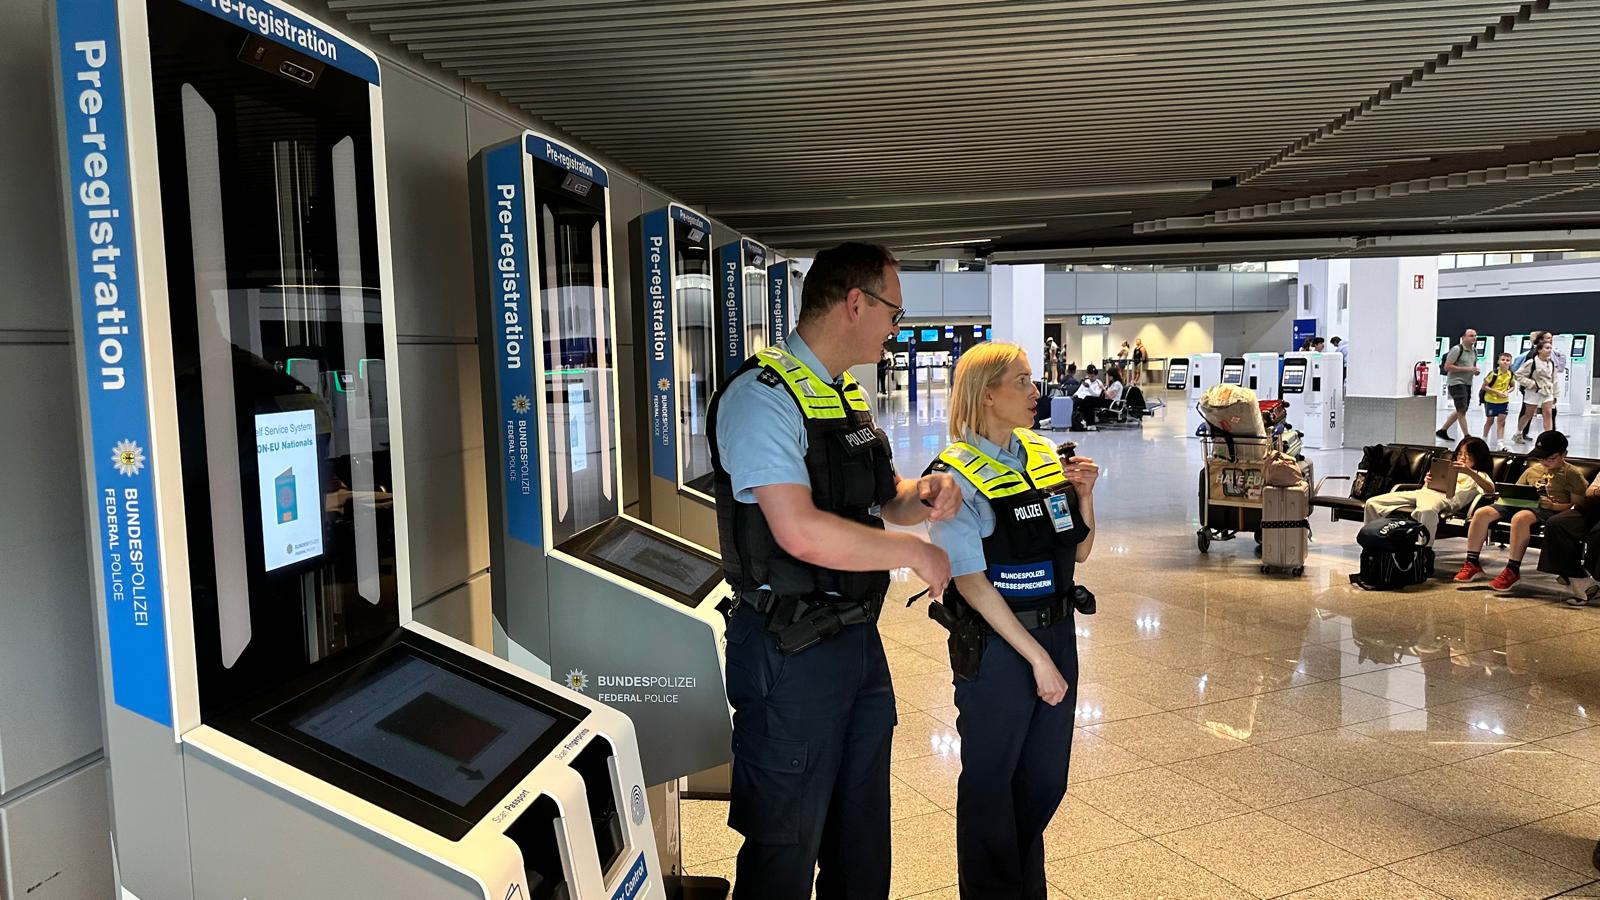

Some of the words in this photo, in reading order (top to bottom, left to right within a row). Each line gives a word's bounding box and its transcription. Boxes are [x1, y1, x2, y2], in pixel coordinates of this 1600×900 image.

[546, 143, 594, 178] Pre-registration
[75, 40, 129, 391] Pre-registration
[497, 184, 525, 369] Pre-registration
[650, 236, 665, 361] Pre-registration
[727, 261, 738, 357] Pre-registration
[774, 279, 784, 343] Pre-registrati
[264, 425, 289, 436] Service
[290, 423, 313, 434] System
[507, 420, 515, 455] FEDERAL
[661, 394, 669, 446] BUNDESPOLIZEI
[845, 427, 877, 448] POLIZEI
[257, 442, 280, 454] ON-EU
[282, 438, 313, 449] Nationals
[518, 420, 530, 495] BUNDESPOLIZEI
[105, 488, 119, 550] FEDERAL
[1014, 503, 1044, 521] POLIZEI
[110, 554, 124, 601] POLICE
[124, 488, 148, 626] BUNDESPOLIZEI
[1000, 569, 1045, 580] BUNDESPOLIZEI
[597, 675, 697, 688] BUNDESPOLIZEI
[598, 693, 642, 703] FEDERAL
[644, 694, 679, 703] POLICE
[492, 810, 510, 824] Scan
[504, 789, 530, 812] Passport
